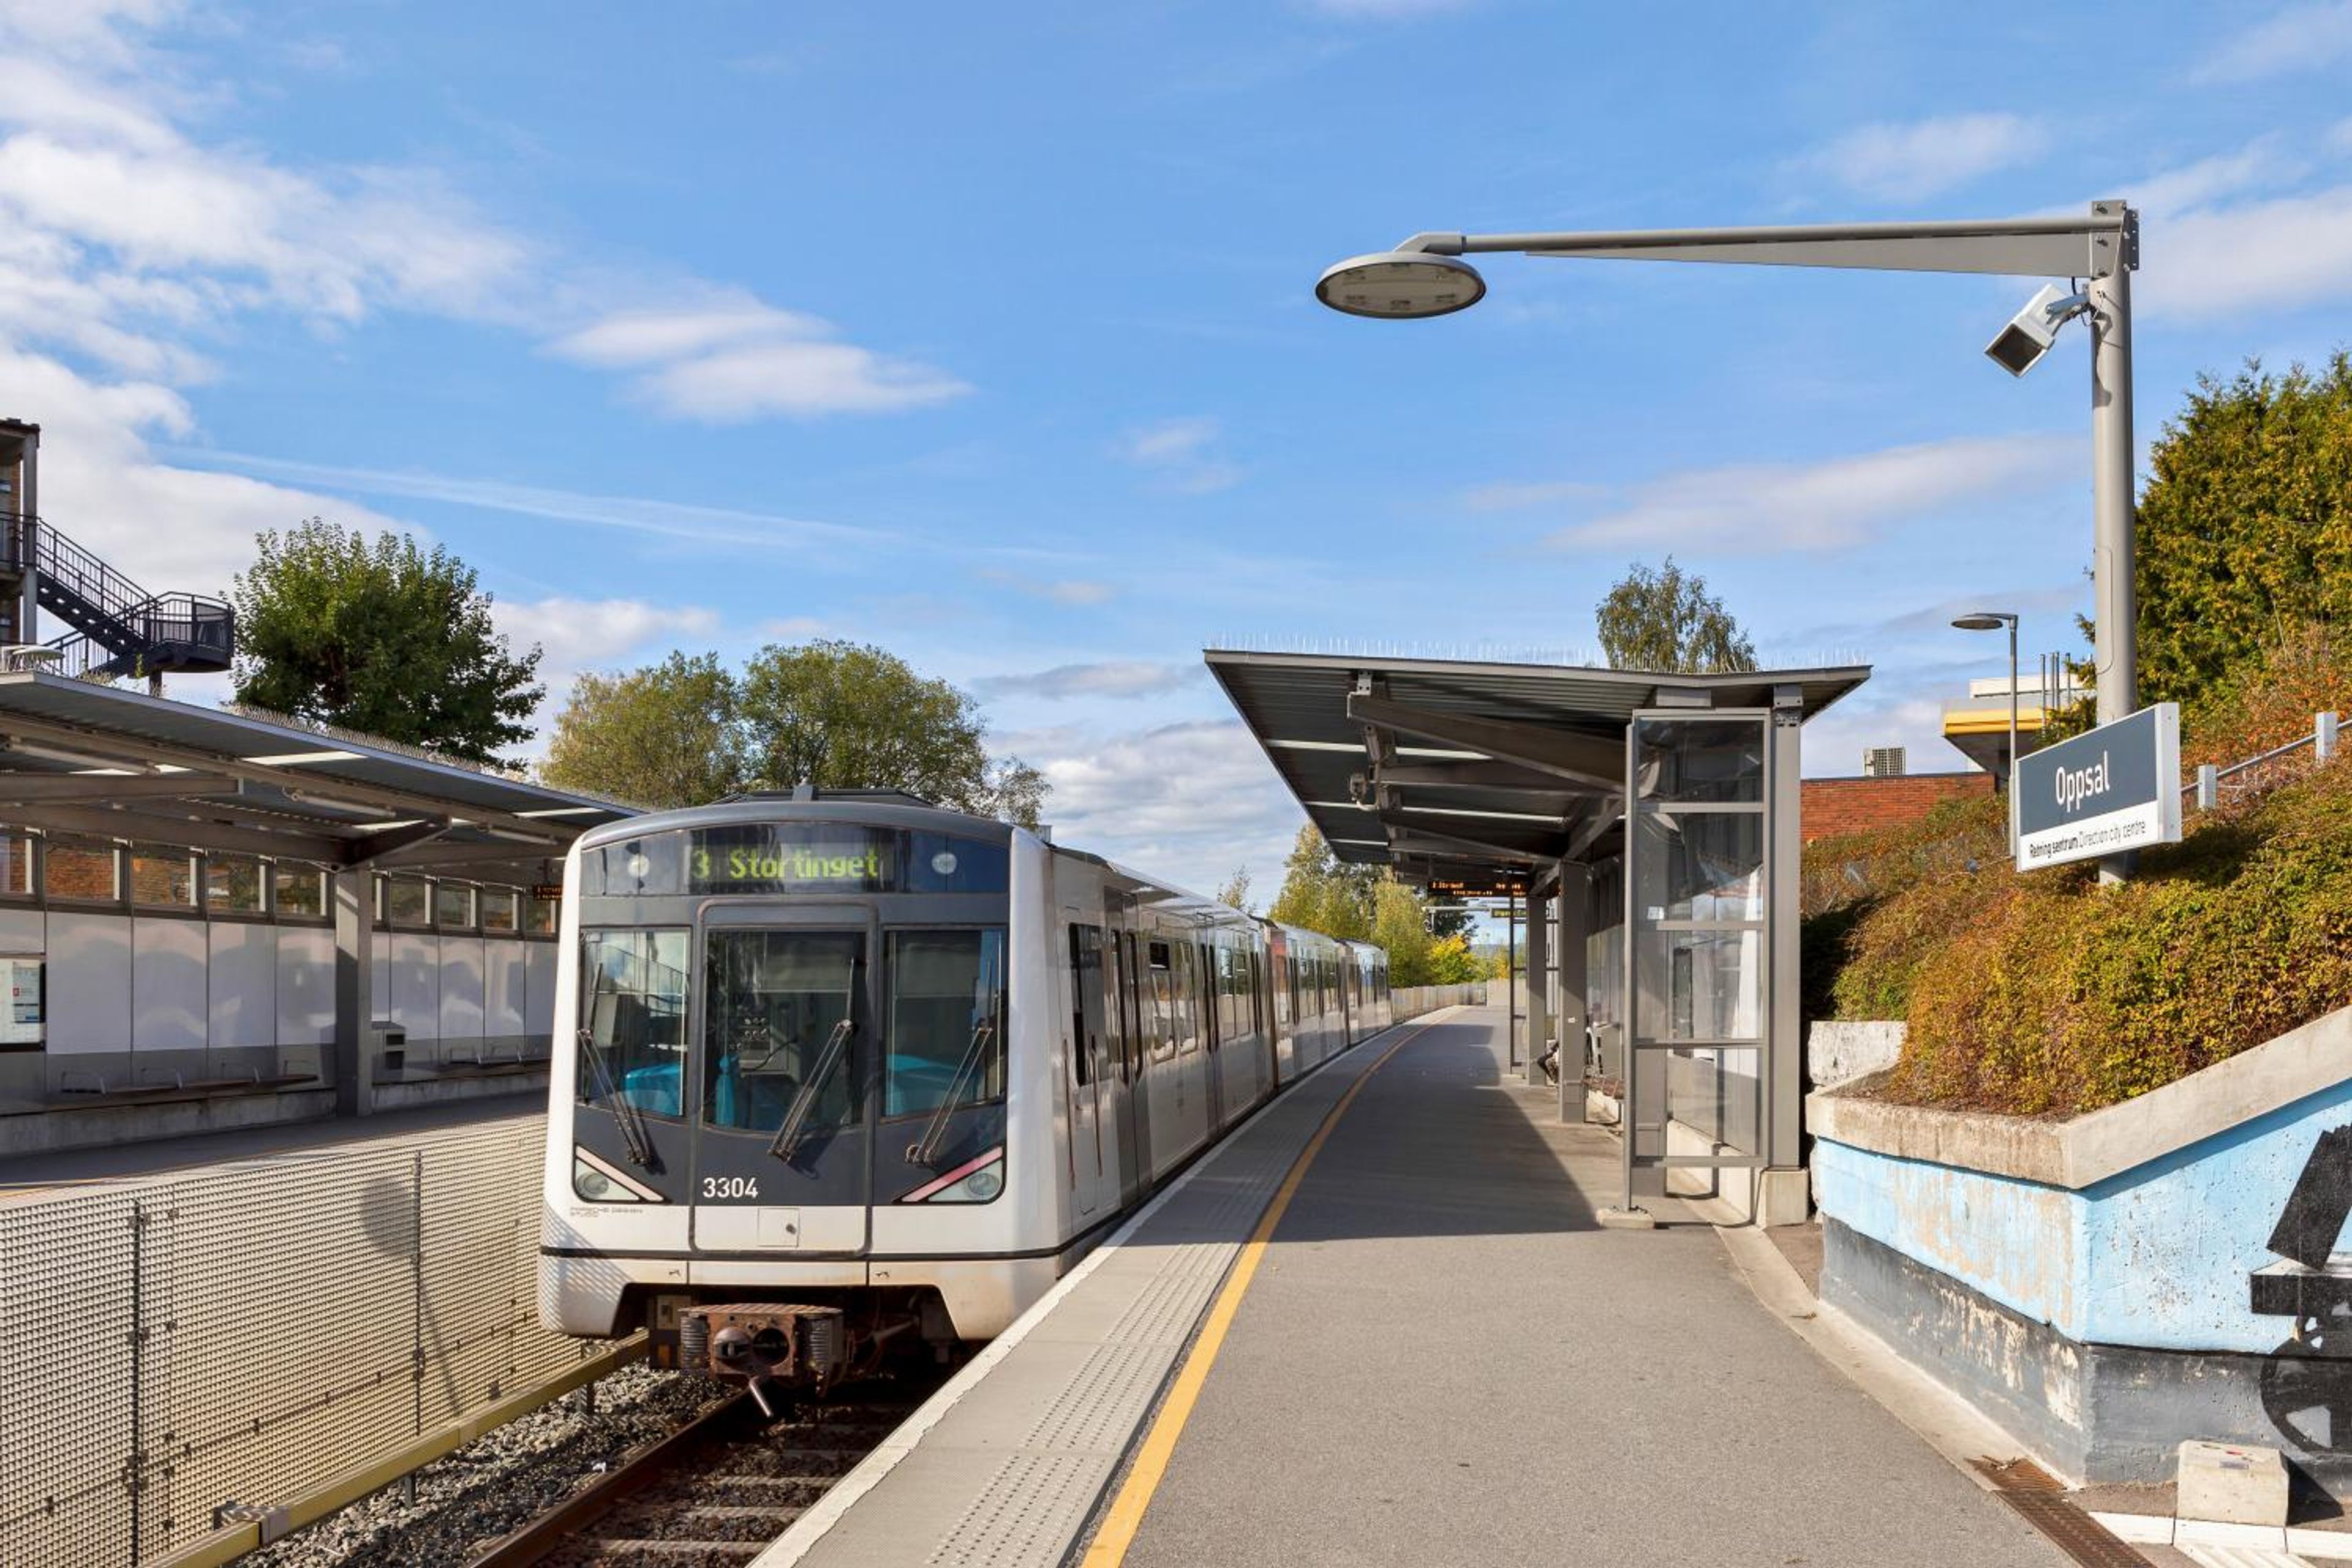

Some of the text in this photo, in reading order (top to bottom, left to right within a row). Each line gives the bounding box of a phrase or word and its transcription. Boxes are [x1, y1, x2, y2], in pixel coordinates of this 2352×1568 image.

[2056, 750, 2109, 813] Oppsal
[2052, 836, 2078, 854] sentrum
[2079, 830, 2108, 848] Direction
[2109, 827, 2121, 843] city
[2123, 820, 2146, 838] centre
[693, 849, 878, 879] 3 Stortinget
[703, 1177, 758, 1198] 3304
